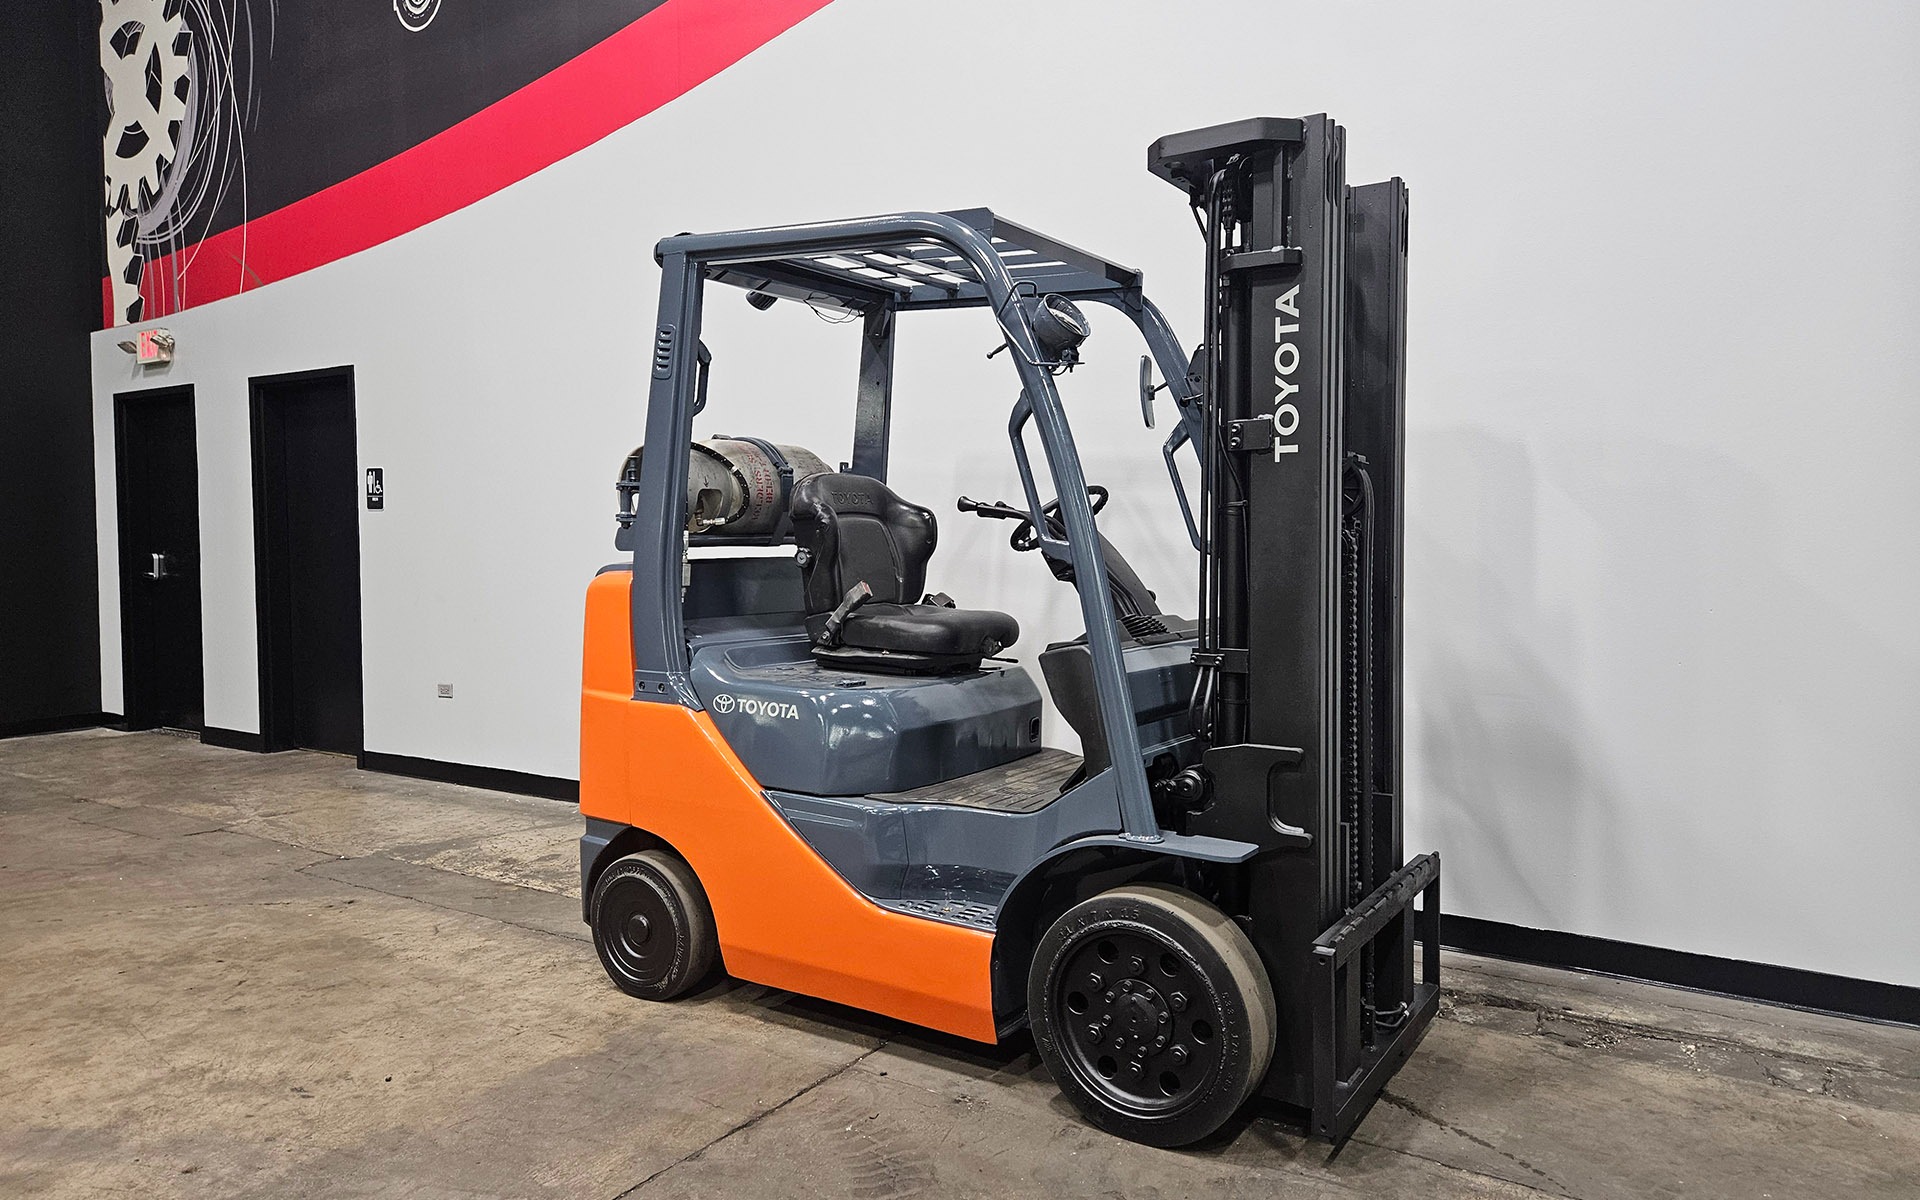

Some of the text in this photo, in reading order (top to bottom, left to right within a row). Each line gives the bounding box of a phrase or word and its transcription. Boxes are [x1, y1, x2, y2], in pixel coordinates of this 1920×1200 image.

[1274, 284, 1300, 463] TOYOTA
[831, 491, 874, 506] TOYOTA
[737, 698, 800, 720] TOYOTA
